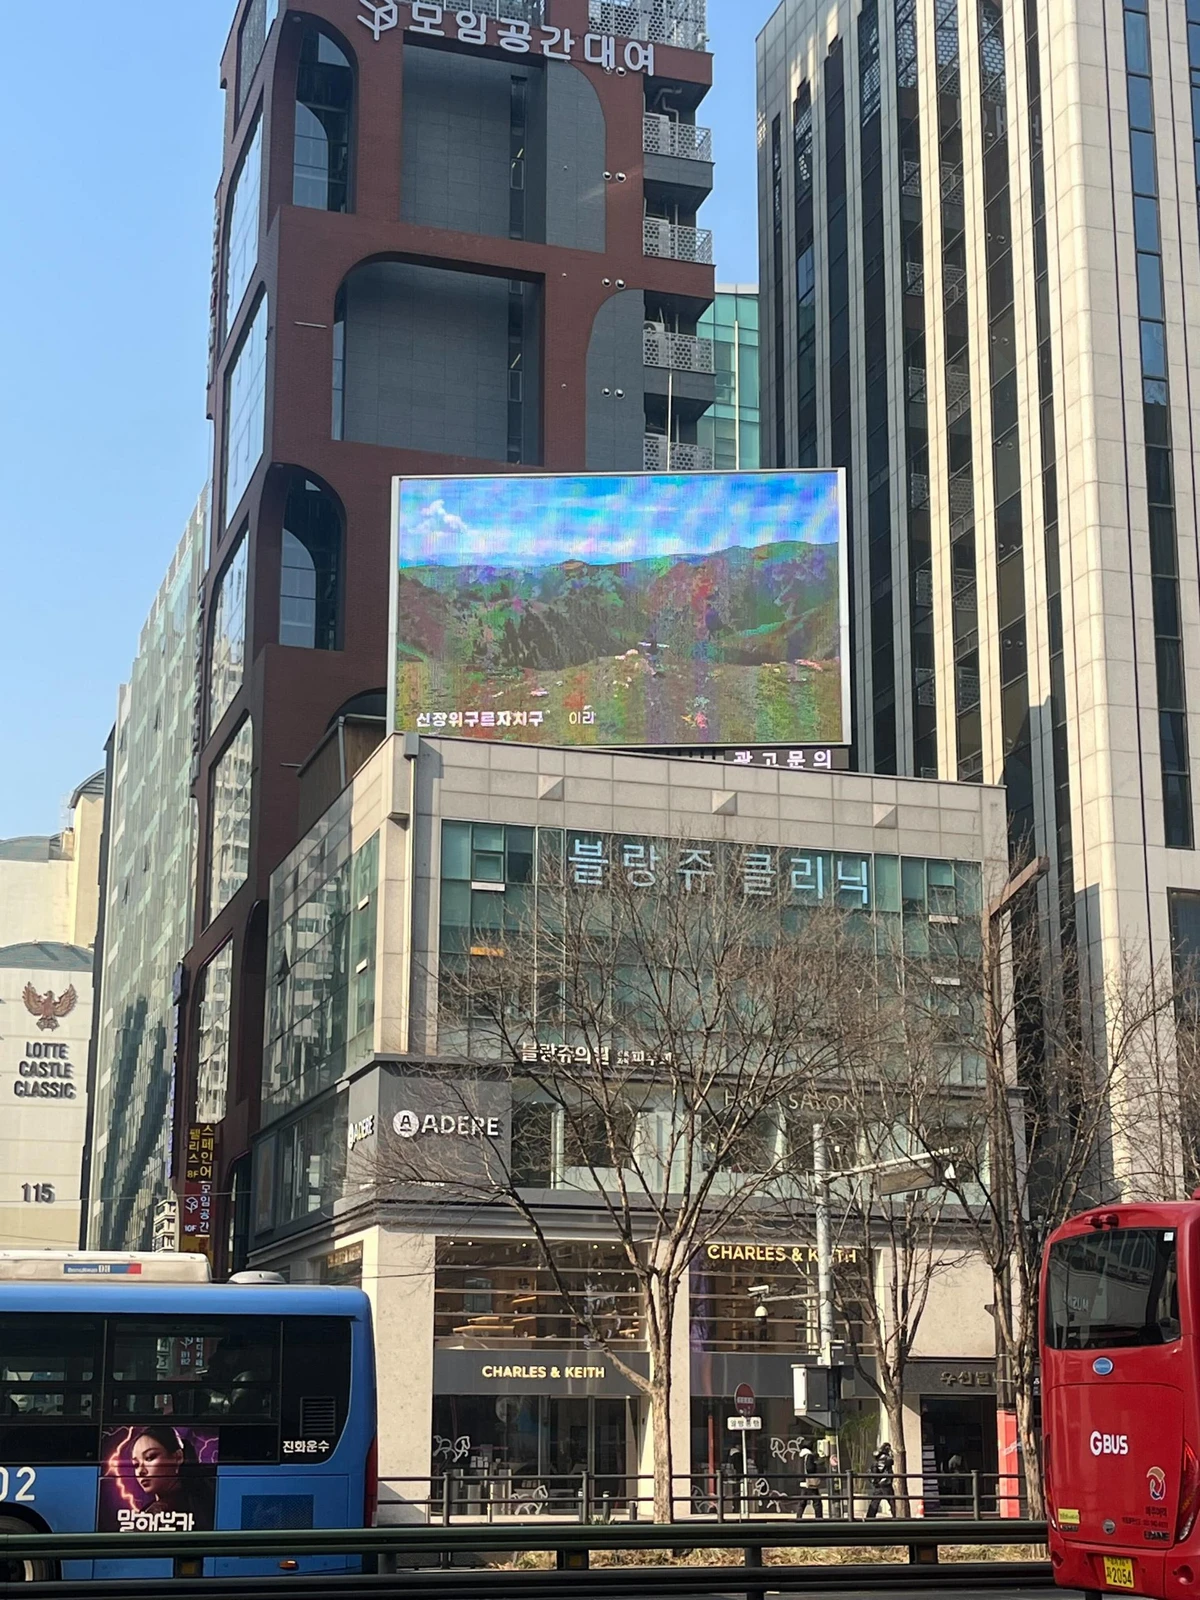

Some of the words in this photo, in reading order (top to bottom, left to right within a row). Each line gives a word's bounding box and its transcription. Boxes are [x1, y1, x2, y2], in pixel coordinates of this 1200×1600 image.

[407, 2, 654, 76] 모임공간대여
[416, 711, 544, 727] 신장위구르자치구
[733, 749, 832, 769] 광고문의
[568, 838, 715, 893] 블랑쥬
[742, 853, 869, 904] 클리닉
[26, 1041, 68, 1060] LOTTE
[19, 1060, 74, 1079] CASTLE
[14, 1080, 76, 1099] CLASSIC
[421, 1114, 499, 1136] ADERE
[199, 1124, 214, 1179] 스페인어
[186, 1169, 199, 1179] 8F
[22, 1182, 56, 1204] 115
[198, 1184, 211, 1233] 모임공간
[184, 1223, 197, 1233] 10F
[707, 1244, 787, 1262] CHARLES
[791, 1247, 804, 1262] &
[808, 1247, 857, 1263] KTH
[481, 1365, 547, 1378] CHARLES
[550, 1366, 561, 1378] &
[564, 1366, 605, 1379] KEITH
[282, 1440, 331, 1454] 진화운수
[117, 1508, 196, 1533] 말해보카
